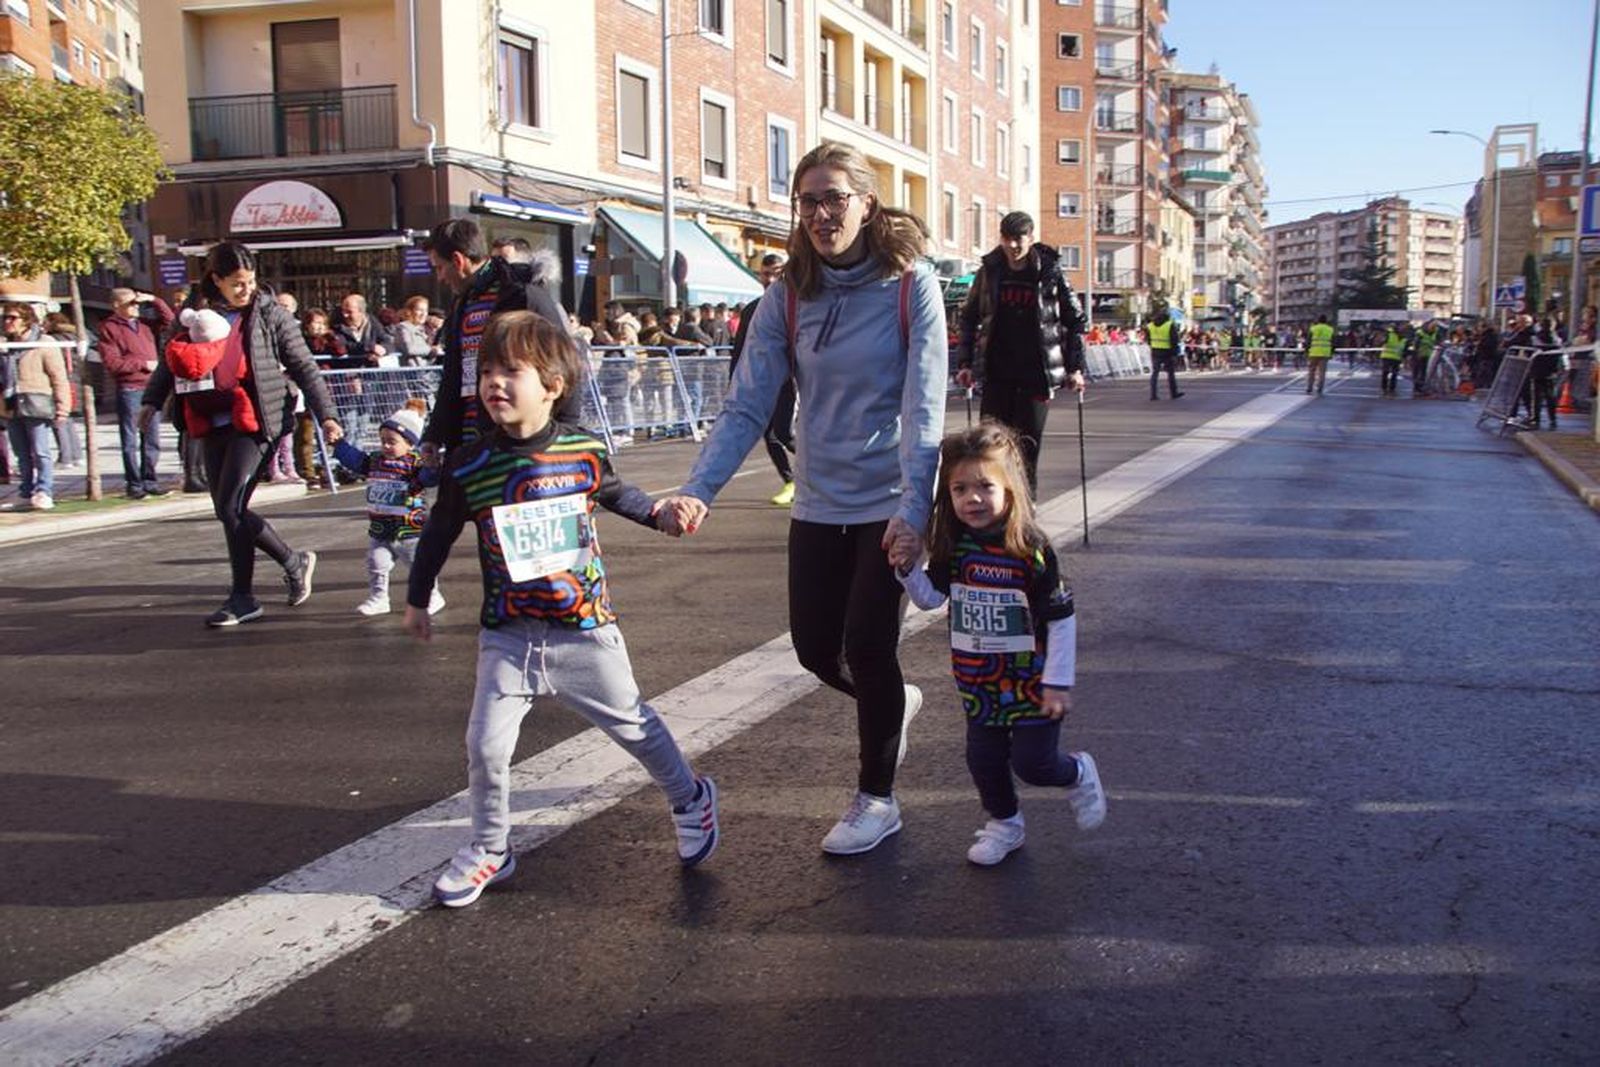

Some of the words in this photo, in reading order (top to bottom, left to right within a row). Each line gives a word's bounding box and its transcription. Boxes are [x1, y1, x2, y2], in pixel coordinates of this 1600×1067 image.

[525, 475, 576, 492] XXXVIII
[522, 501, 579, 520] SETEL
[514, 518, 566, 555] 6314
[973, 564, 1013, 580] XXXVIII
[967, 590, 1023, 604] SETEL
[962, 602, 1008, 632] 6315
